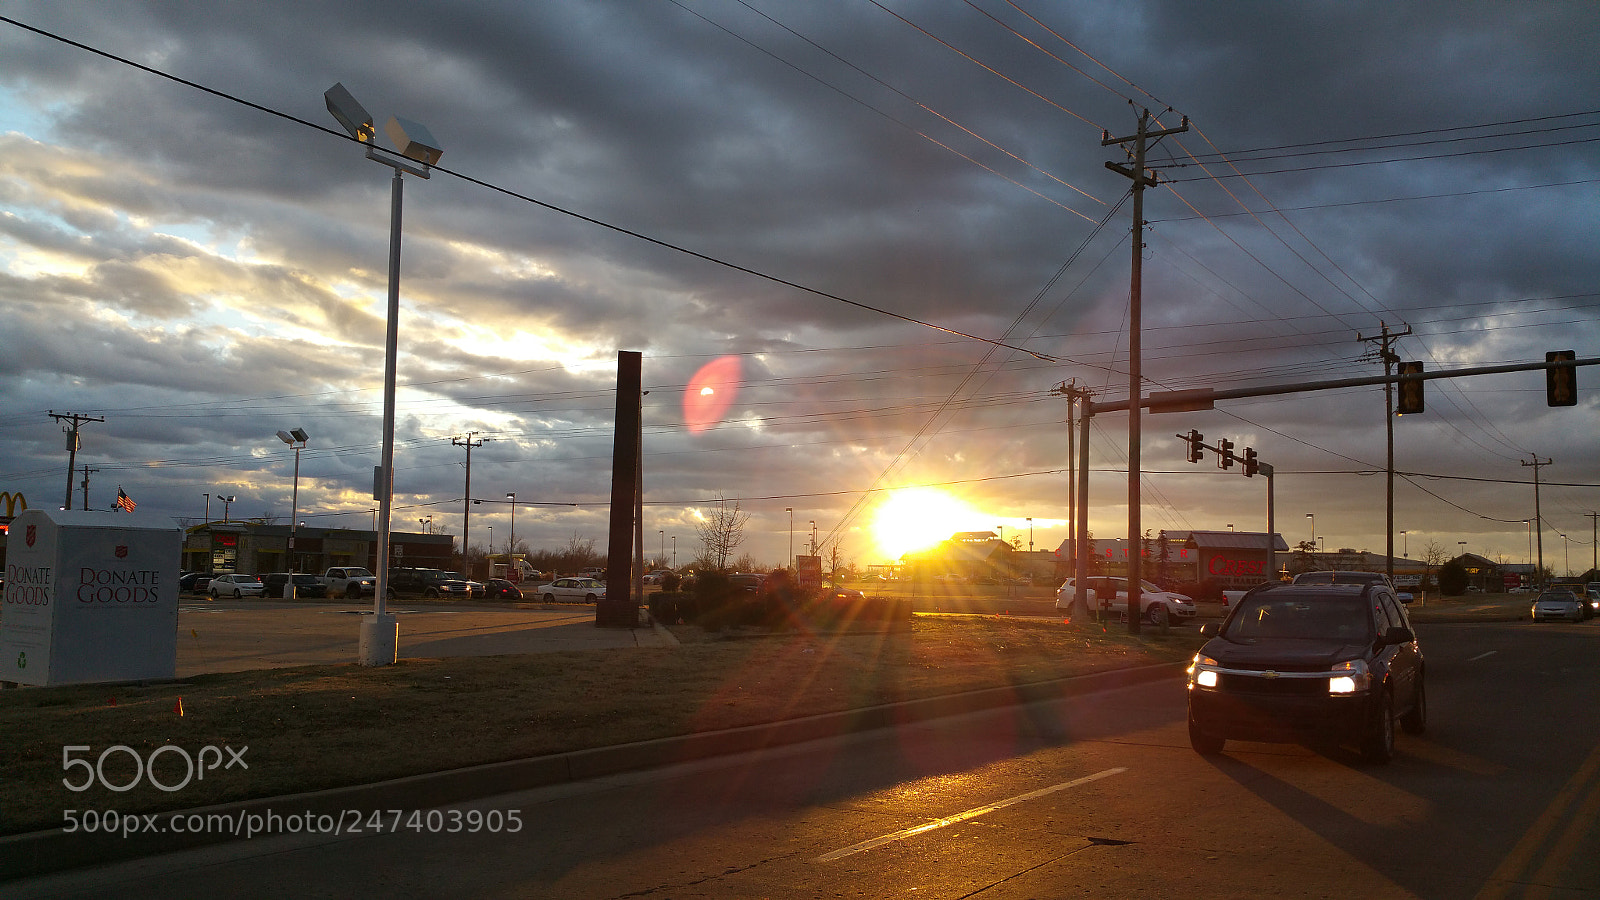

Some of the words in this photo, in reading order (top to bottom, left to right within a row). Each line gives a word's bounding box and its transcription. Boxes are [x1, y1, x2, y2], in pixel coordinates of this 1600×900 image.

[8, 564, 51, 584] DONATE
[80, 567, 160, 585] DONATE
[1209, 555, 1267, 577] CREST
[6, 583, 49, 606] GOODS
[77, 583, 159, 603] GOODS
